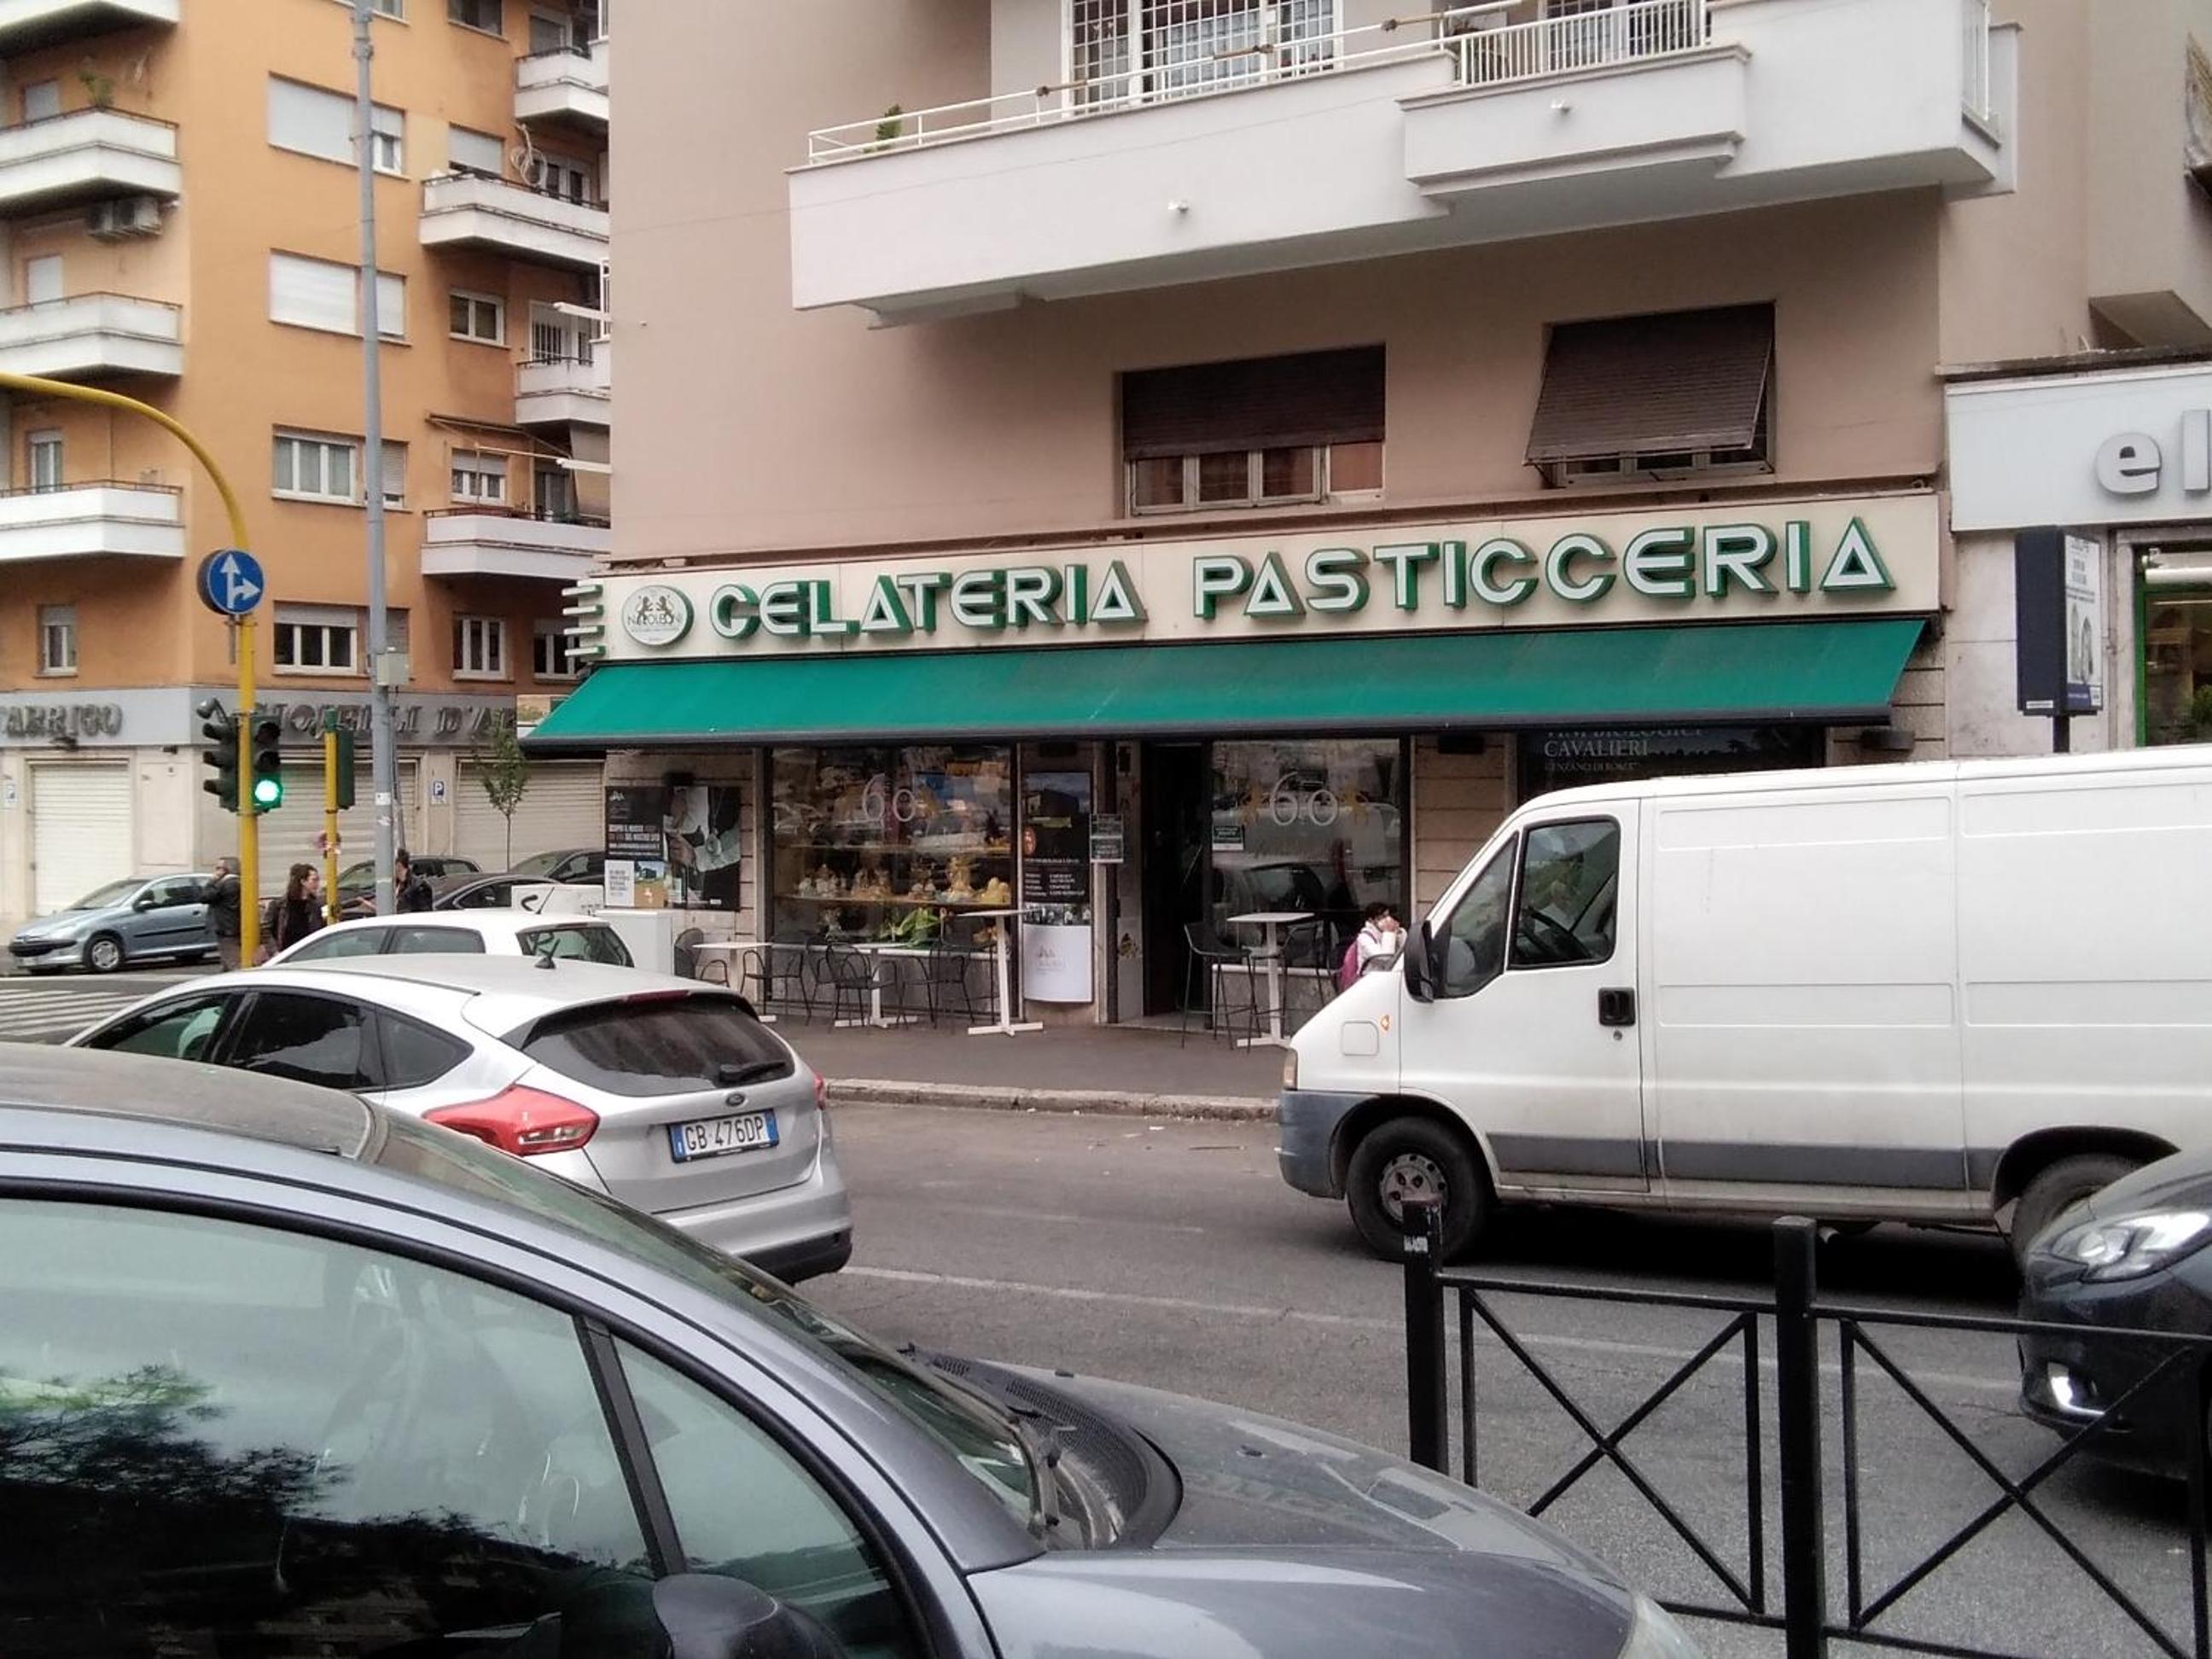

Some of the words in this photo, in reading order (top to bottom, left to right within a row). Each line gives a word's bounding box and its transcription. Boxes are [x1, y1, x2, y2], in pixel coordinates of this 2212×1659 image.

[1192, 515, 1896, 620] PASTICCERIA
[1544, 739, 1648, 758] CAVALIERI
[862, 772, 916, 822] 60
[1270, 771, 1339, 826] 60
[684, 1123, 707, 1151] GB
[714, 1116, 764, 1146] 476DP
